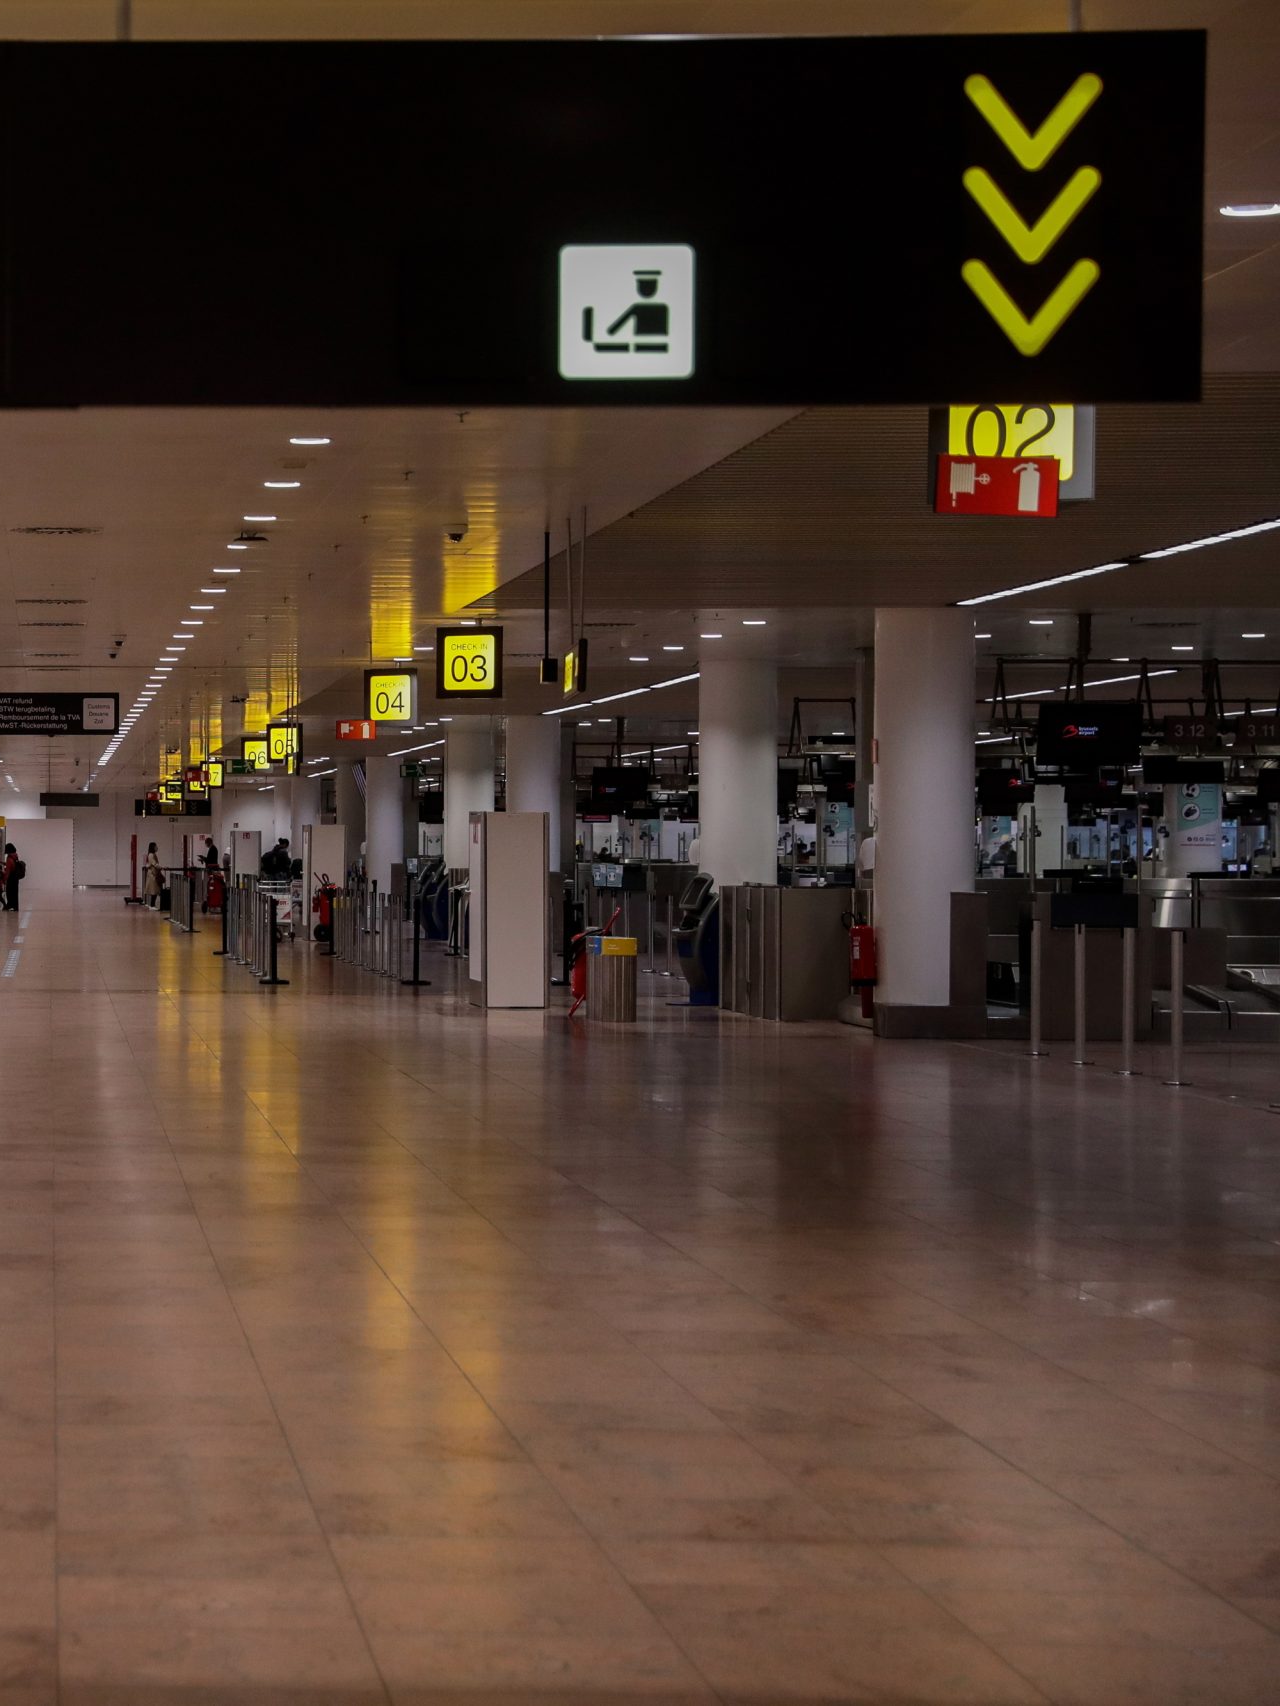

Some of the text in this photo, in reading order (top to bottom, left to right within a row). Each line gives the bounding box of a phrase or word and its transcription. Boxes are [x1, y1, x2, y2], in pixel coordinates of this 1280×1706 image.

[965, 402, 1056, 458] 02
[450, 643, 478, 651] CHECK
[450, 654, 488, 683] 03
[15, 706, 56, 714] terugbetaling
[375, 691, 405, 714] 04
